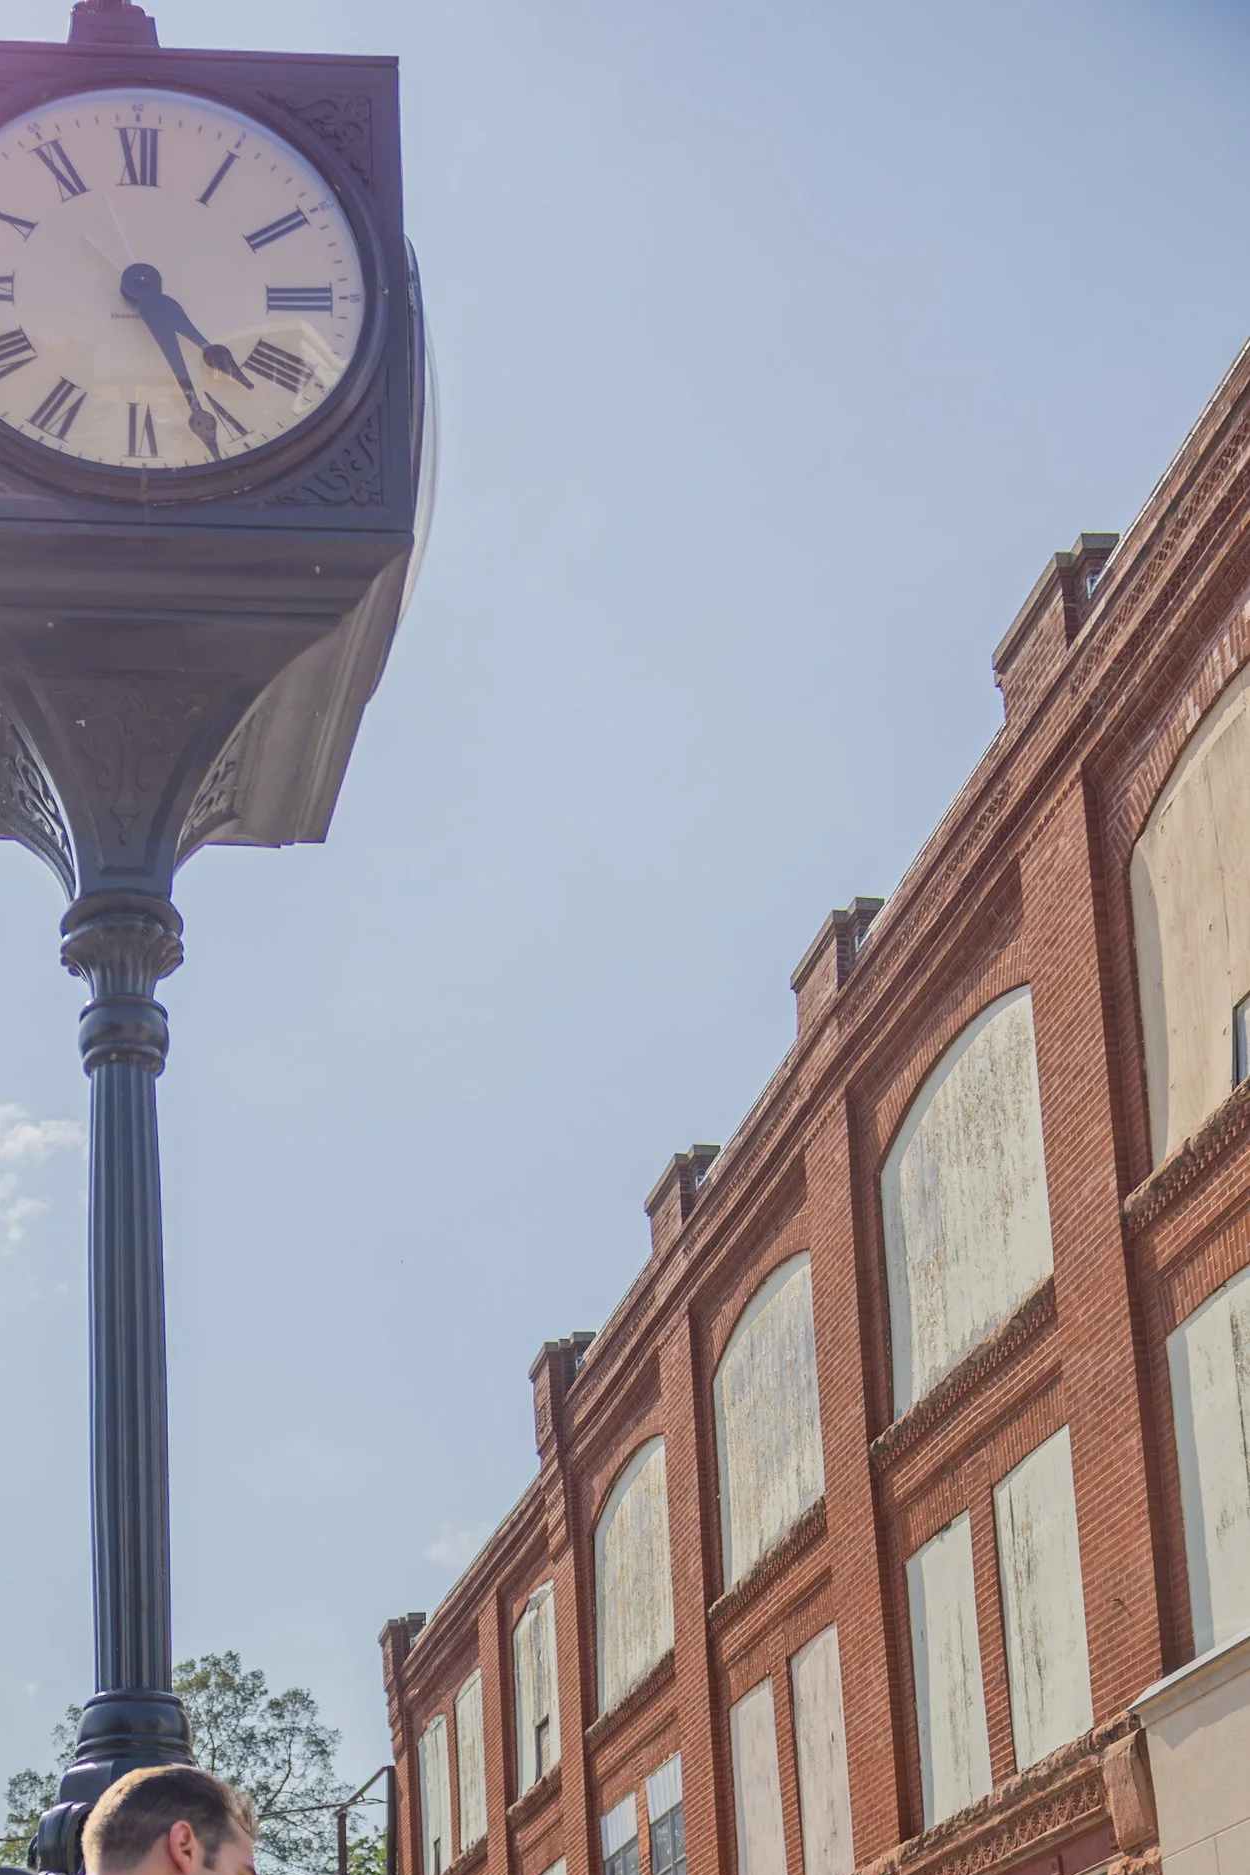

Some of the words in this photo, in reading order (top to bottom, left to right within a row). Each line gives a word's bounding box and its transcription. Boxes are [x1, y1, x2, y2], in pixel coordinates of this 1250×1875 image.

[27, 137, 93, 204] XI
[114, 126, 164, 188] XII
[195, 149, 241, 208] I
[241, 204, 311, 255] II
[265, 282, 333, 318] III
[24, 375, 88, 443] VII
[123, 401, 164, 459] VI
[204, 391, 256, 444] V
